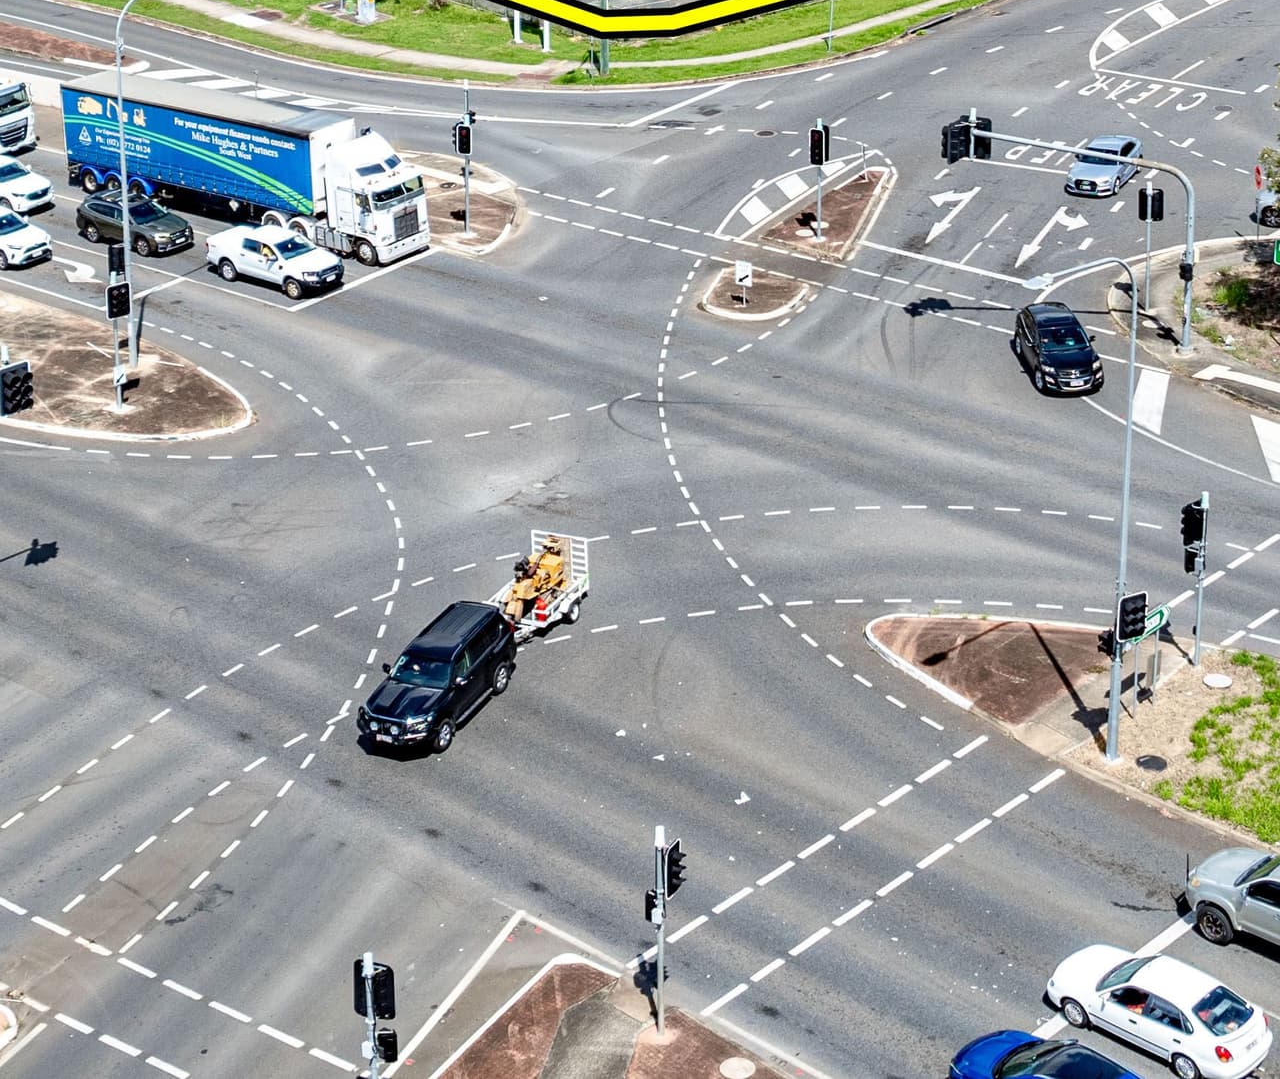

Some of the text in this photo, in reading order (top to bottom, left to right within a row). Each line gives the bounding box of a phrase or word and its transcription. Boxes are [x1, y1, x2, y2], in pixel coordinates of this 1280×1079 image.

[1078, 75, 1208, 111] CLEAR
[192, 131, 279, 158] Mike Hughes & Partners
